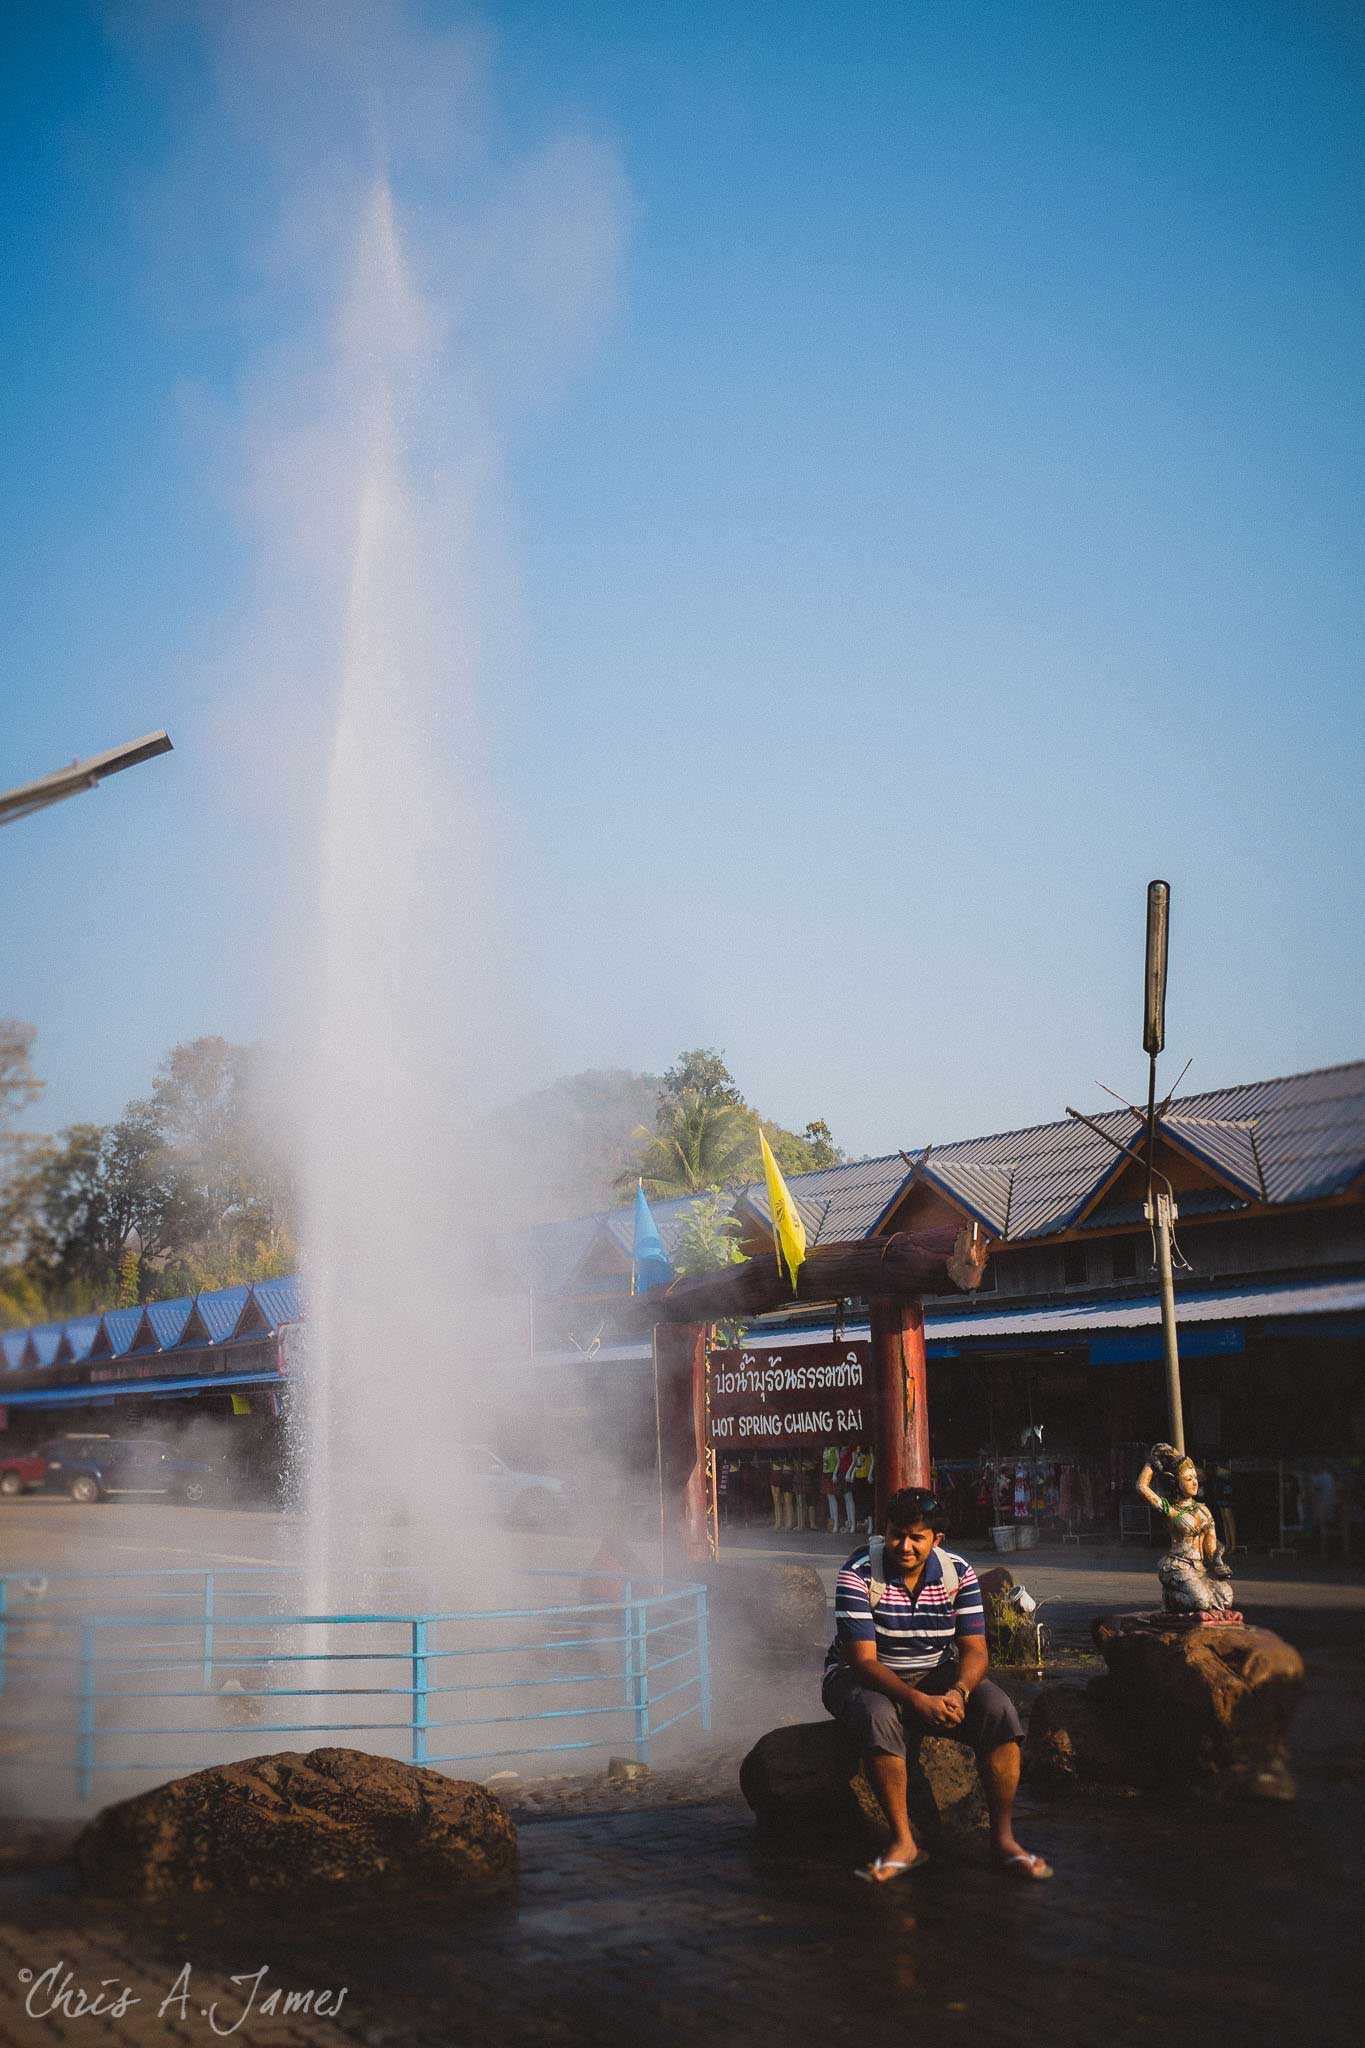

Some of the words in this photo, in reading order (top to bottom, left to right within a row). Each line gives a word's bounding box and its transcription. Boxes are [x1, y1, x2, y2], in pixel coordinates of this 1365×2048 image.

[711, 1416, 735, 1437] HOT
[738, 1414, 783, 1437] SPRING
[784, 1410, 834, 1434] CHIANG
[836, 1408, 863, 1432] RAI
